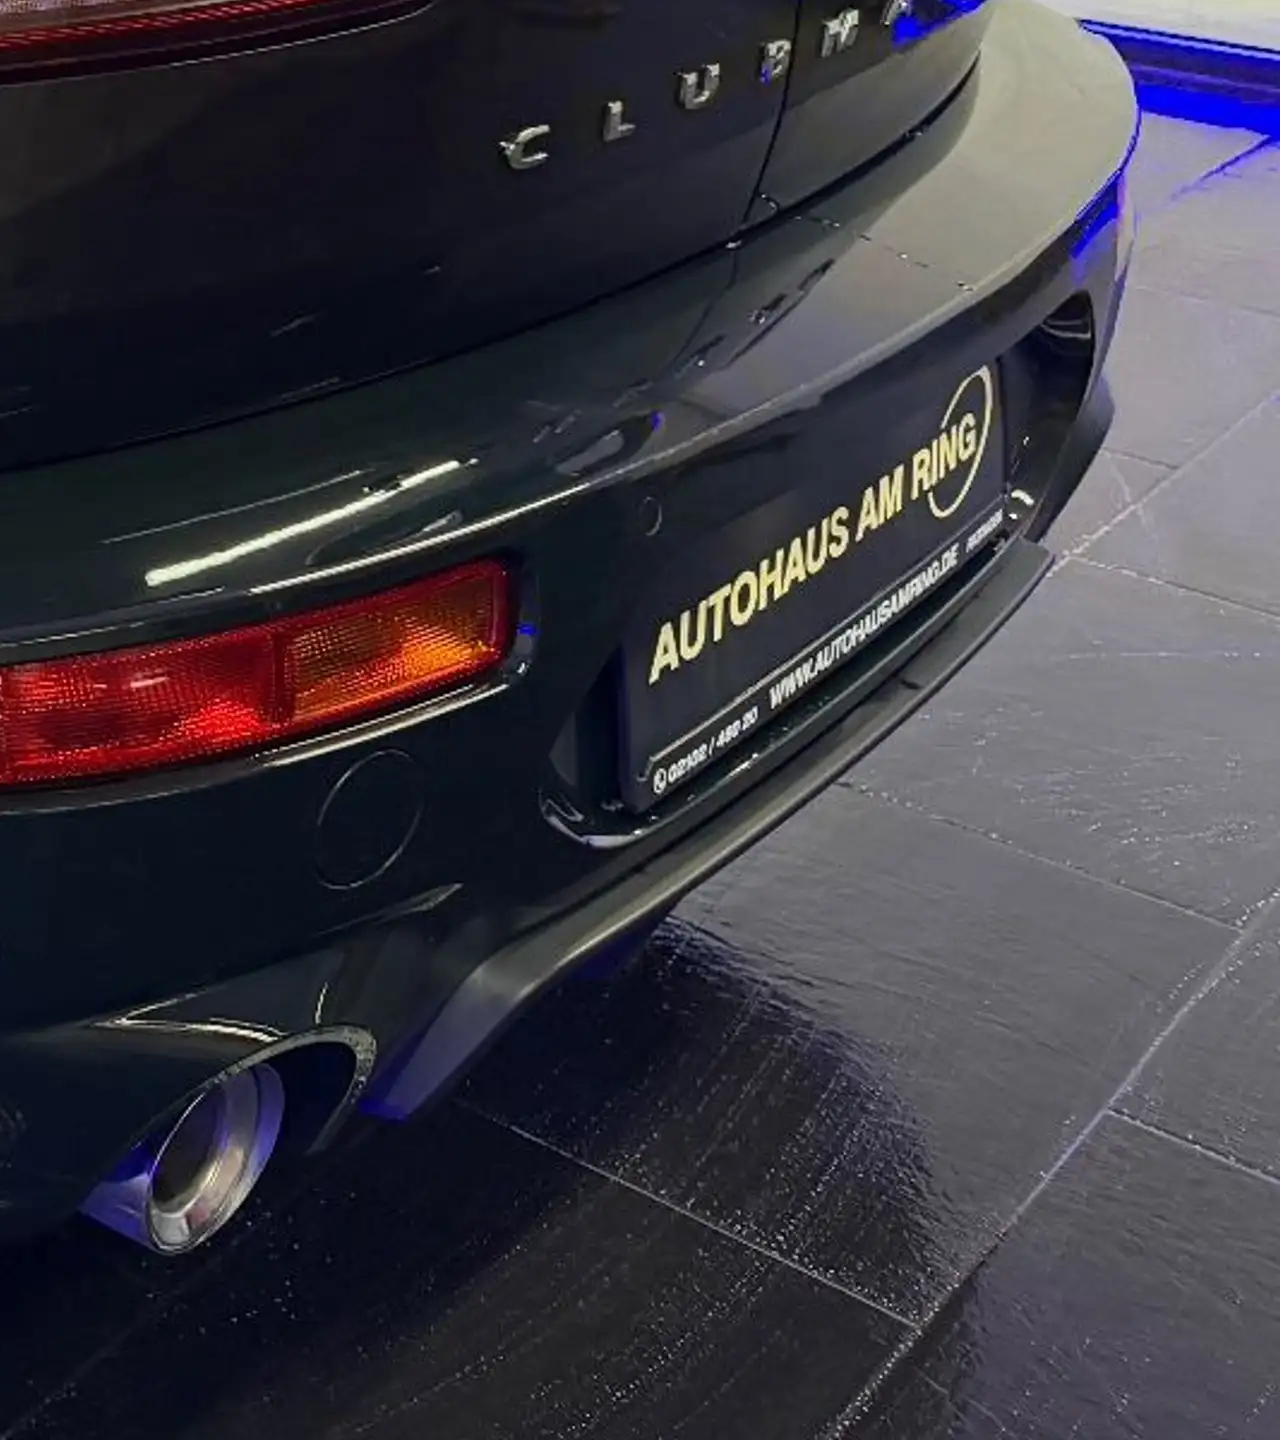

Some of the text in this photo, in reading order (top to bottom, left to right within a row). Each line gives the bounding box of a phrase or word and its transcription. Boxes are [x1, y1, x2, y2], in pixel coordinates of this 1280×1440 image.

[648, 505, 849, 685] AUTOHAUS
[855, 464, 903, 543] AM
[910, 411, 977, 502] RING
